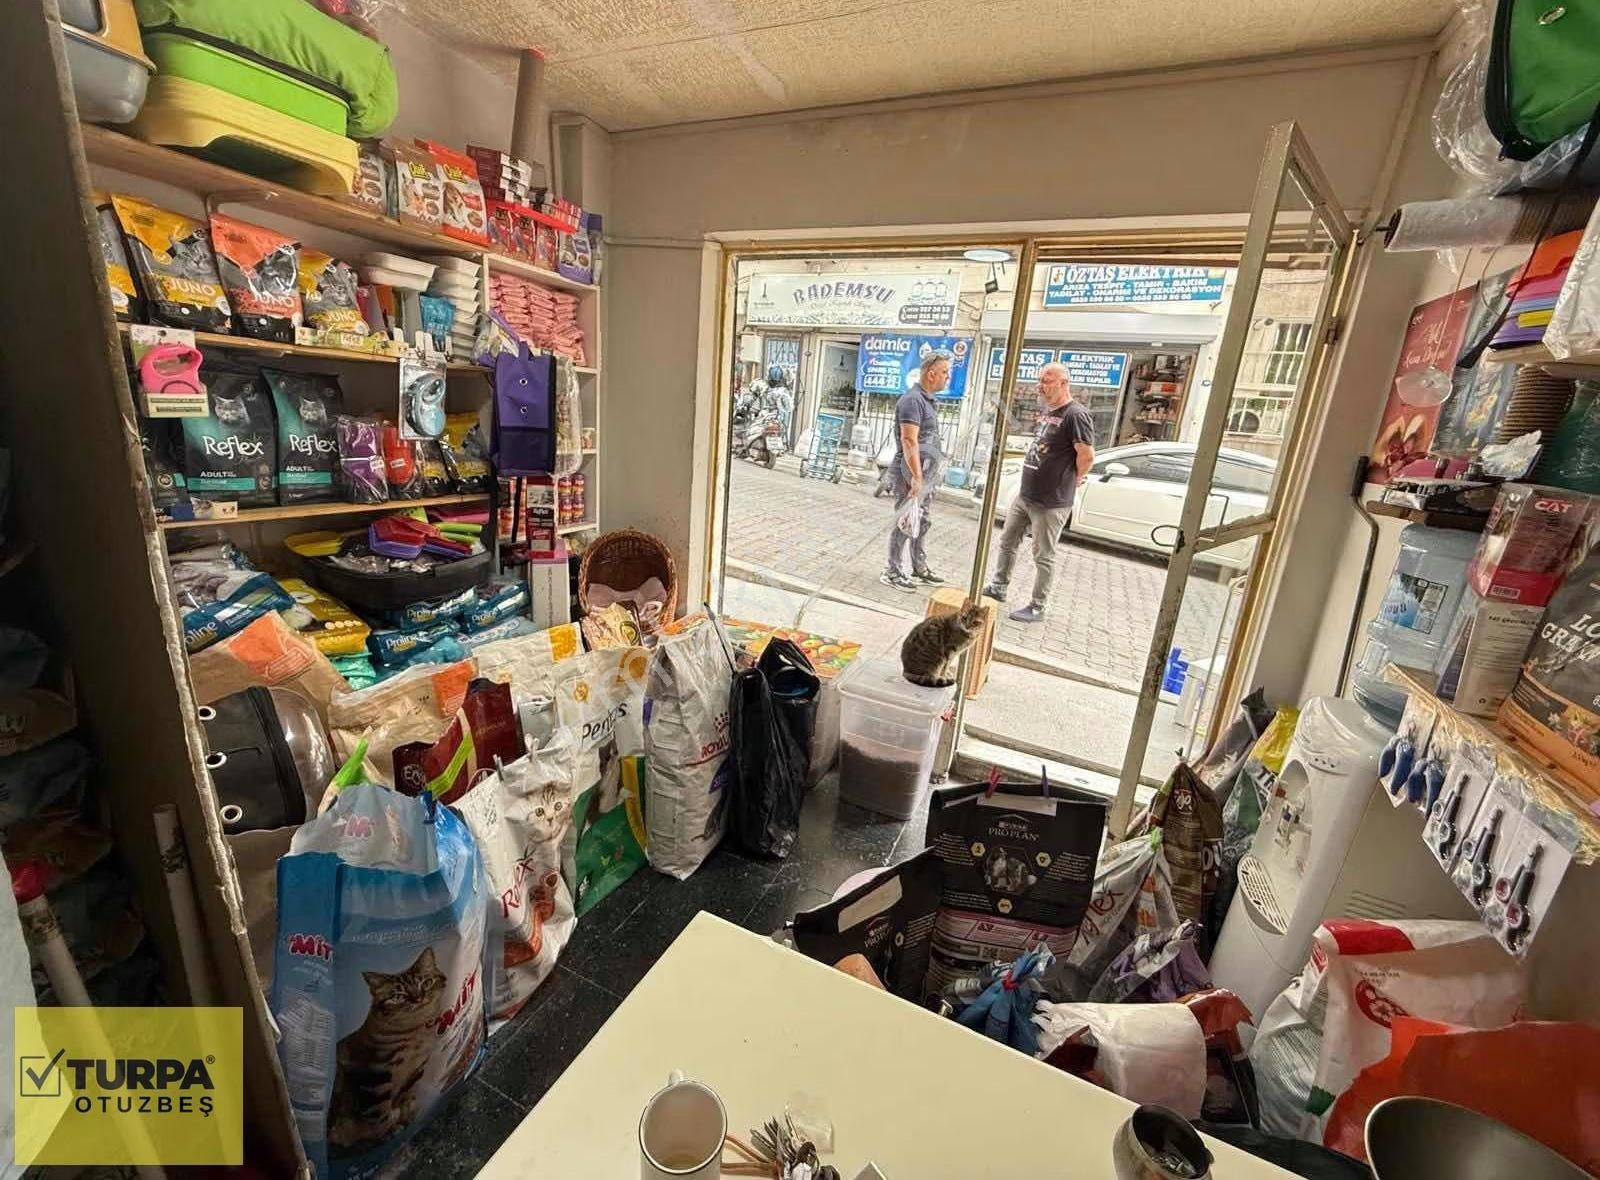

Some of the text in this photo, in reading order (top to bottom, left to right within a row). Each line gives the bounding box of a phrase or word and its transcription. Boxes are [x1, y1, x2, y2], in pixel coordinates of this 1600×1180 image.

[169, 278, 215, 296] JUNO
[865, 337, 911, 351] damla
[202, 435, 264, 459] Reflex
[289, 434, 338, 456] Reflex
[1534, 500, 1573, 512] CAT
